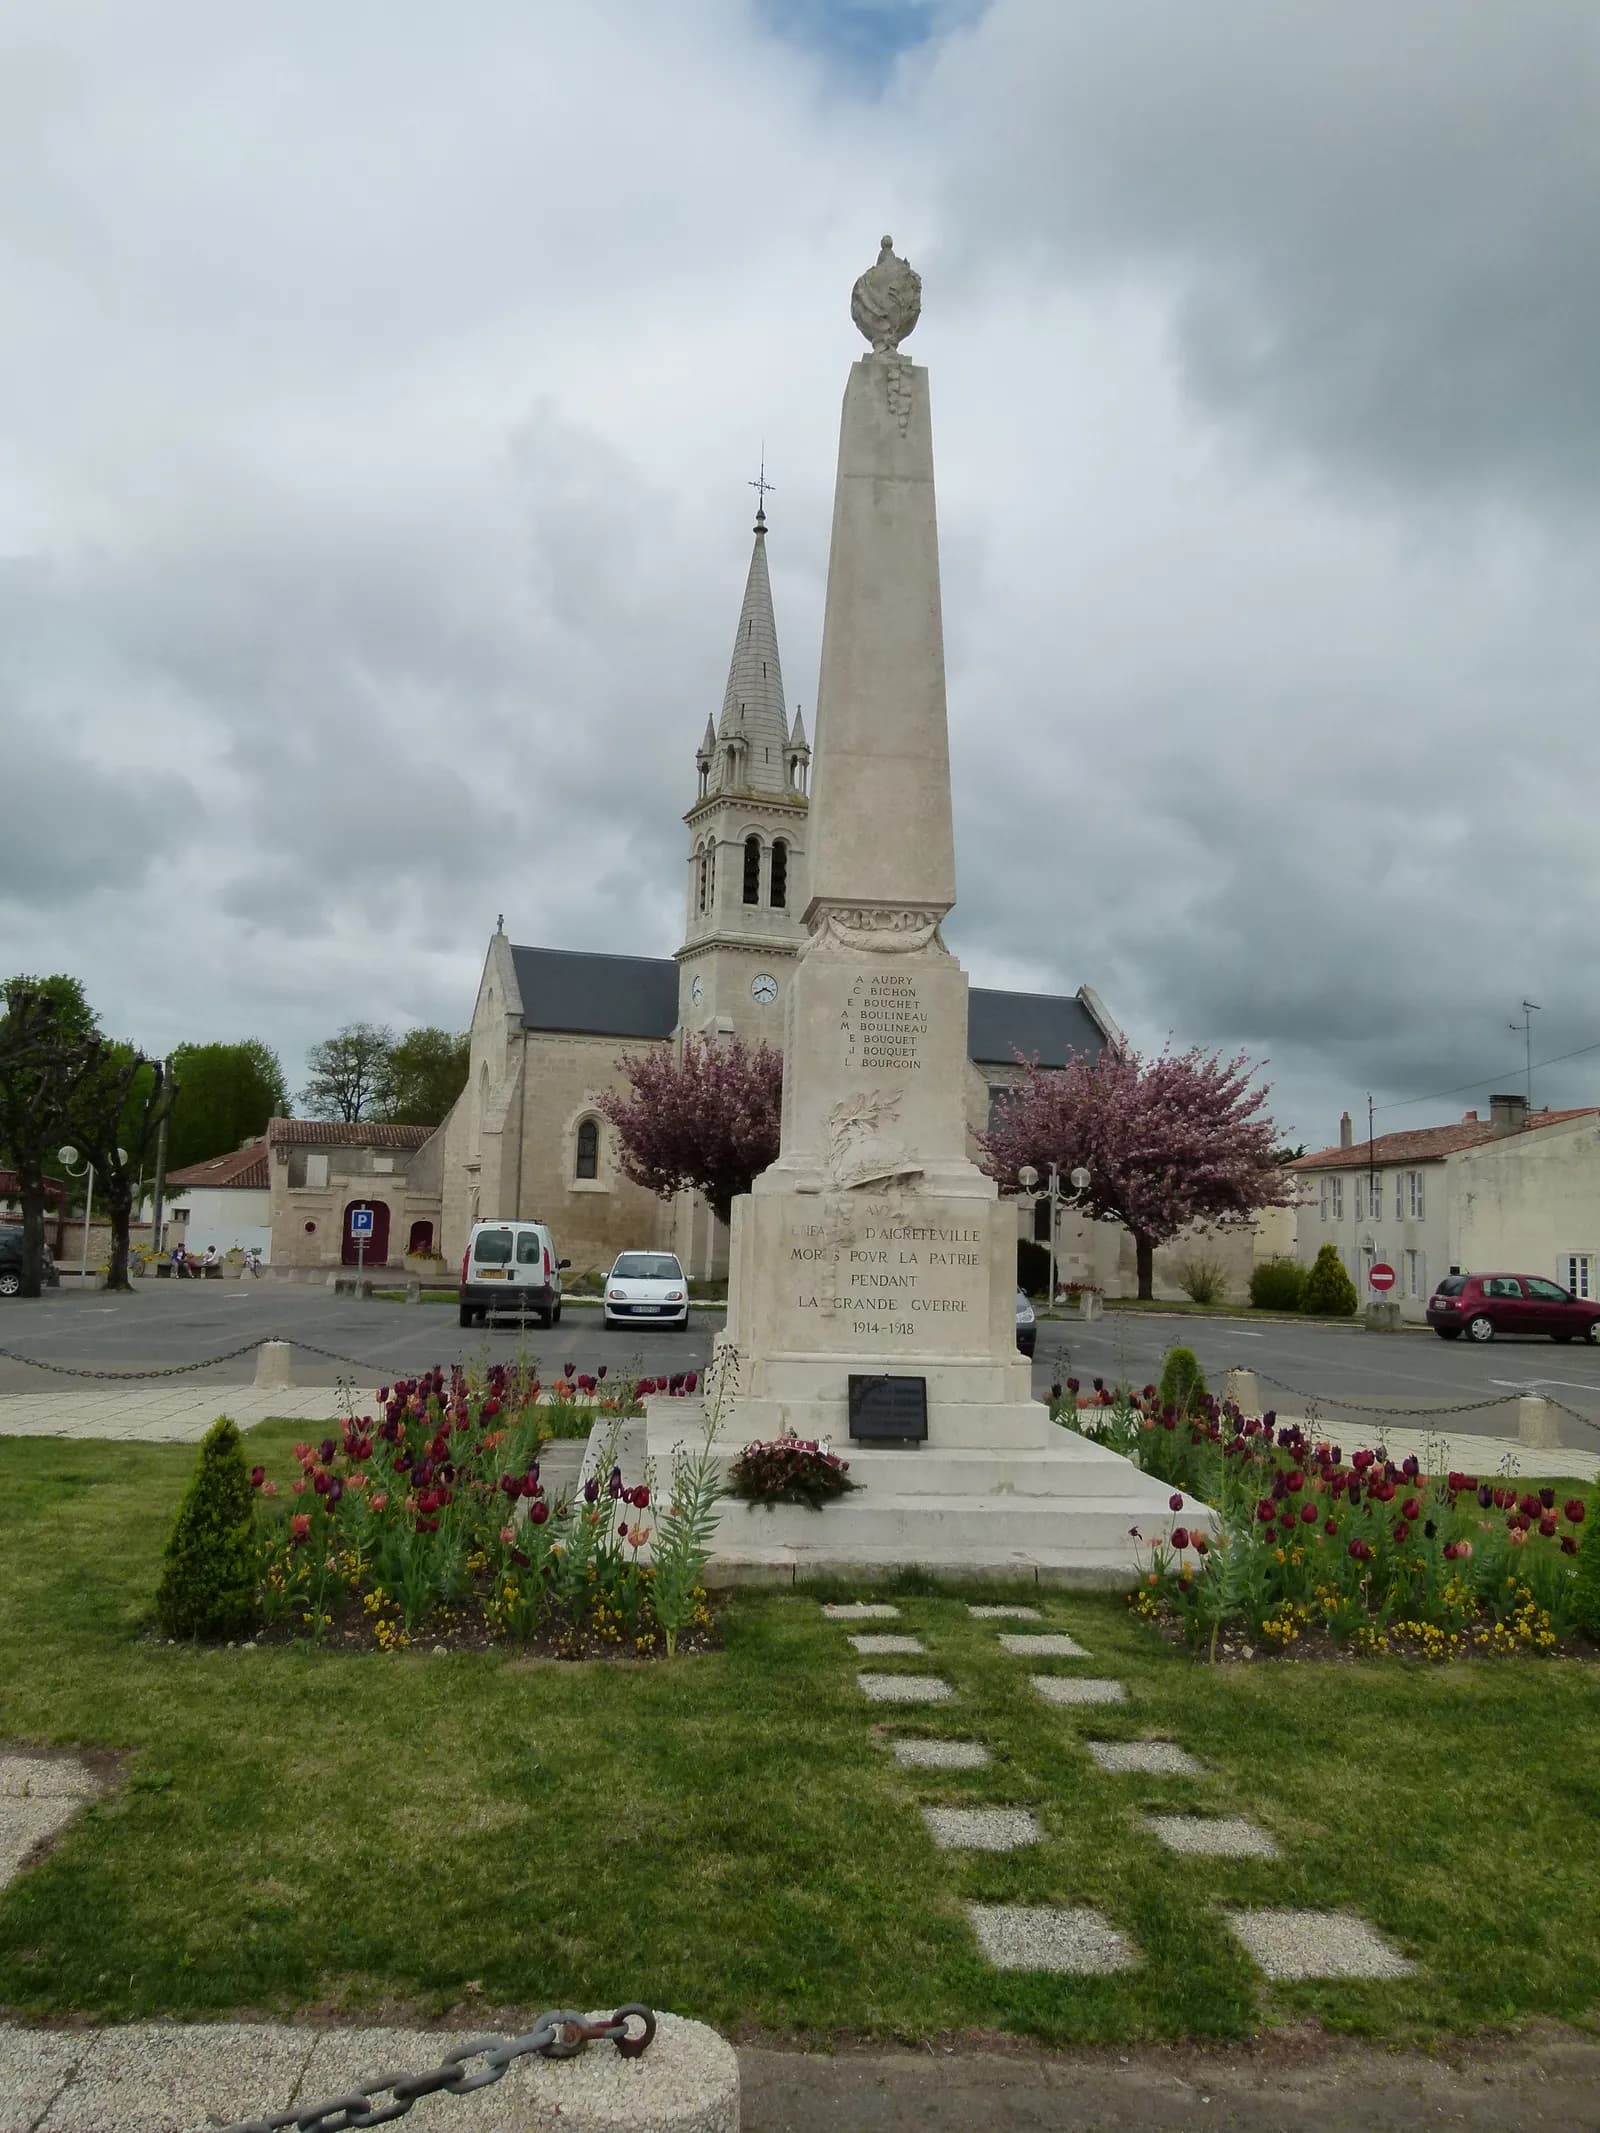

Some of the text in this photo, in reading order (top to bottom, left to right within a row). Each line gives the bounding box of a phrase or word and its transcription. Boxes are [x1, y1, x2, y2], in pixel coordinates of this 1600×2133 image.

[872, 976, 913, 985] AUDRY
[853, 987, 916, 997] C BICHON
[848, 998, 920, 1009] E BOUCHET
[860, 1011, 928, 1021] BOULINEAU
[841, 1022, 928, 1033] M BOULINEAU
[849, 1034, 917, 1045] E BOUQUET
[863, 1046, 917, 1057] BOUQUET
[862, 1059, 921, 1069] BOURGOIN
[358, 1214, 368, 1227] P
[850, 1250, 888, 1263] POVR
[900, 1252, 918, 1264] LA
[929, 1253, 980, 1266] PATRIE
[851, 1274, 917, 1287] PENDANT
[799, 1296, 969, 1313] LA GRANDE GVERRE
[853, 1322, 914, 1335] 1914-1918
